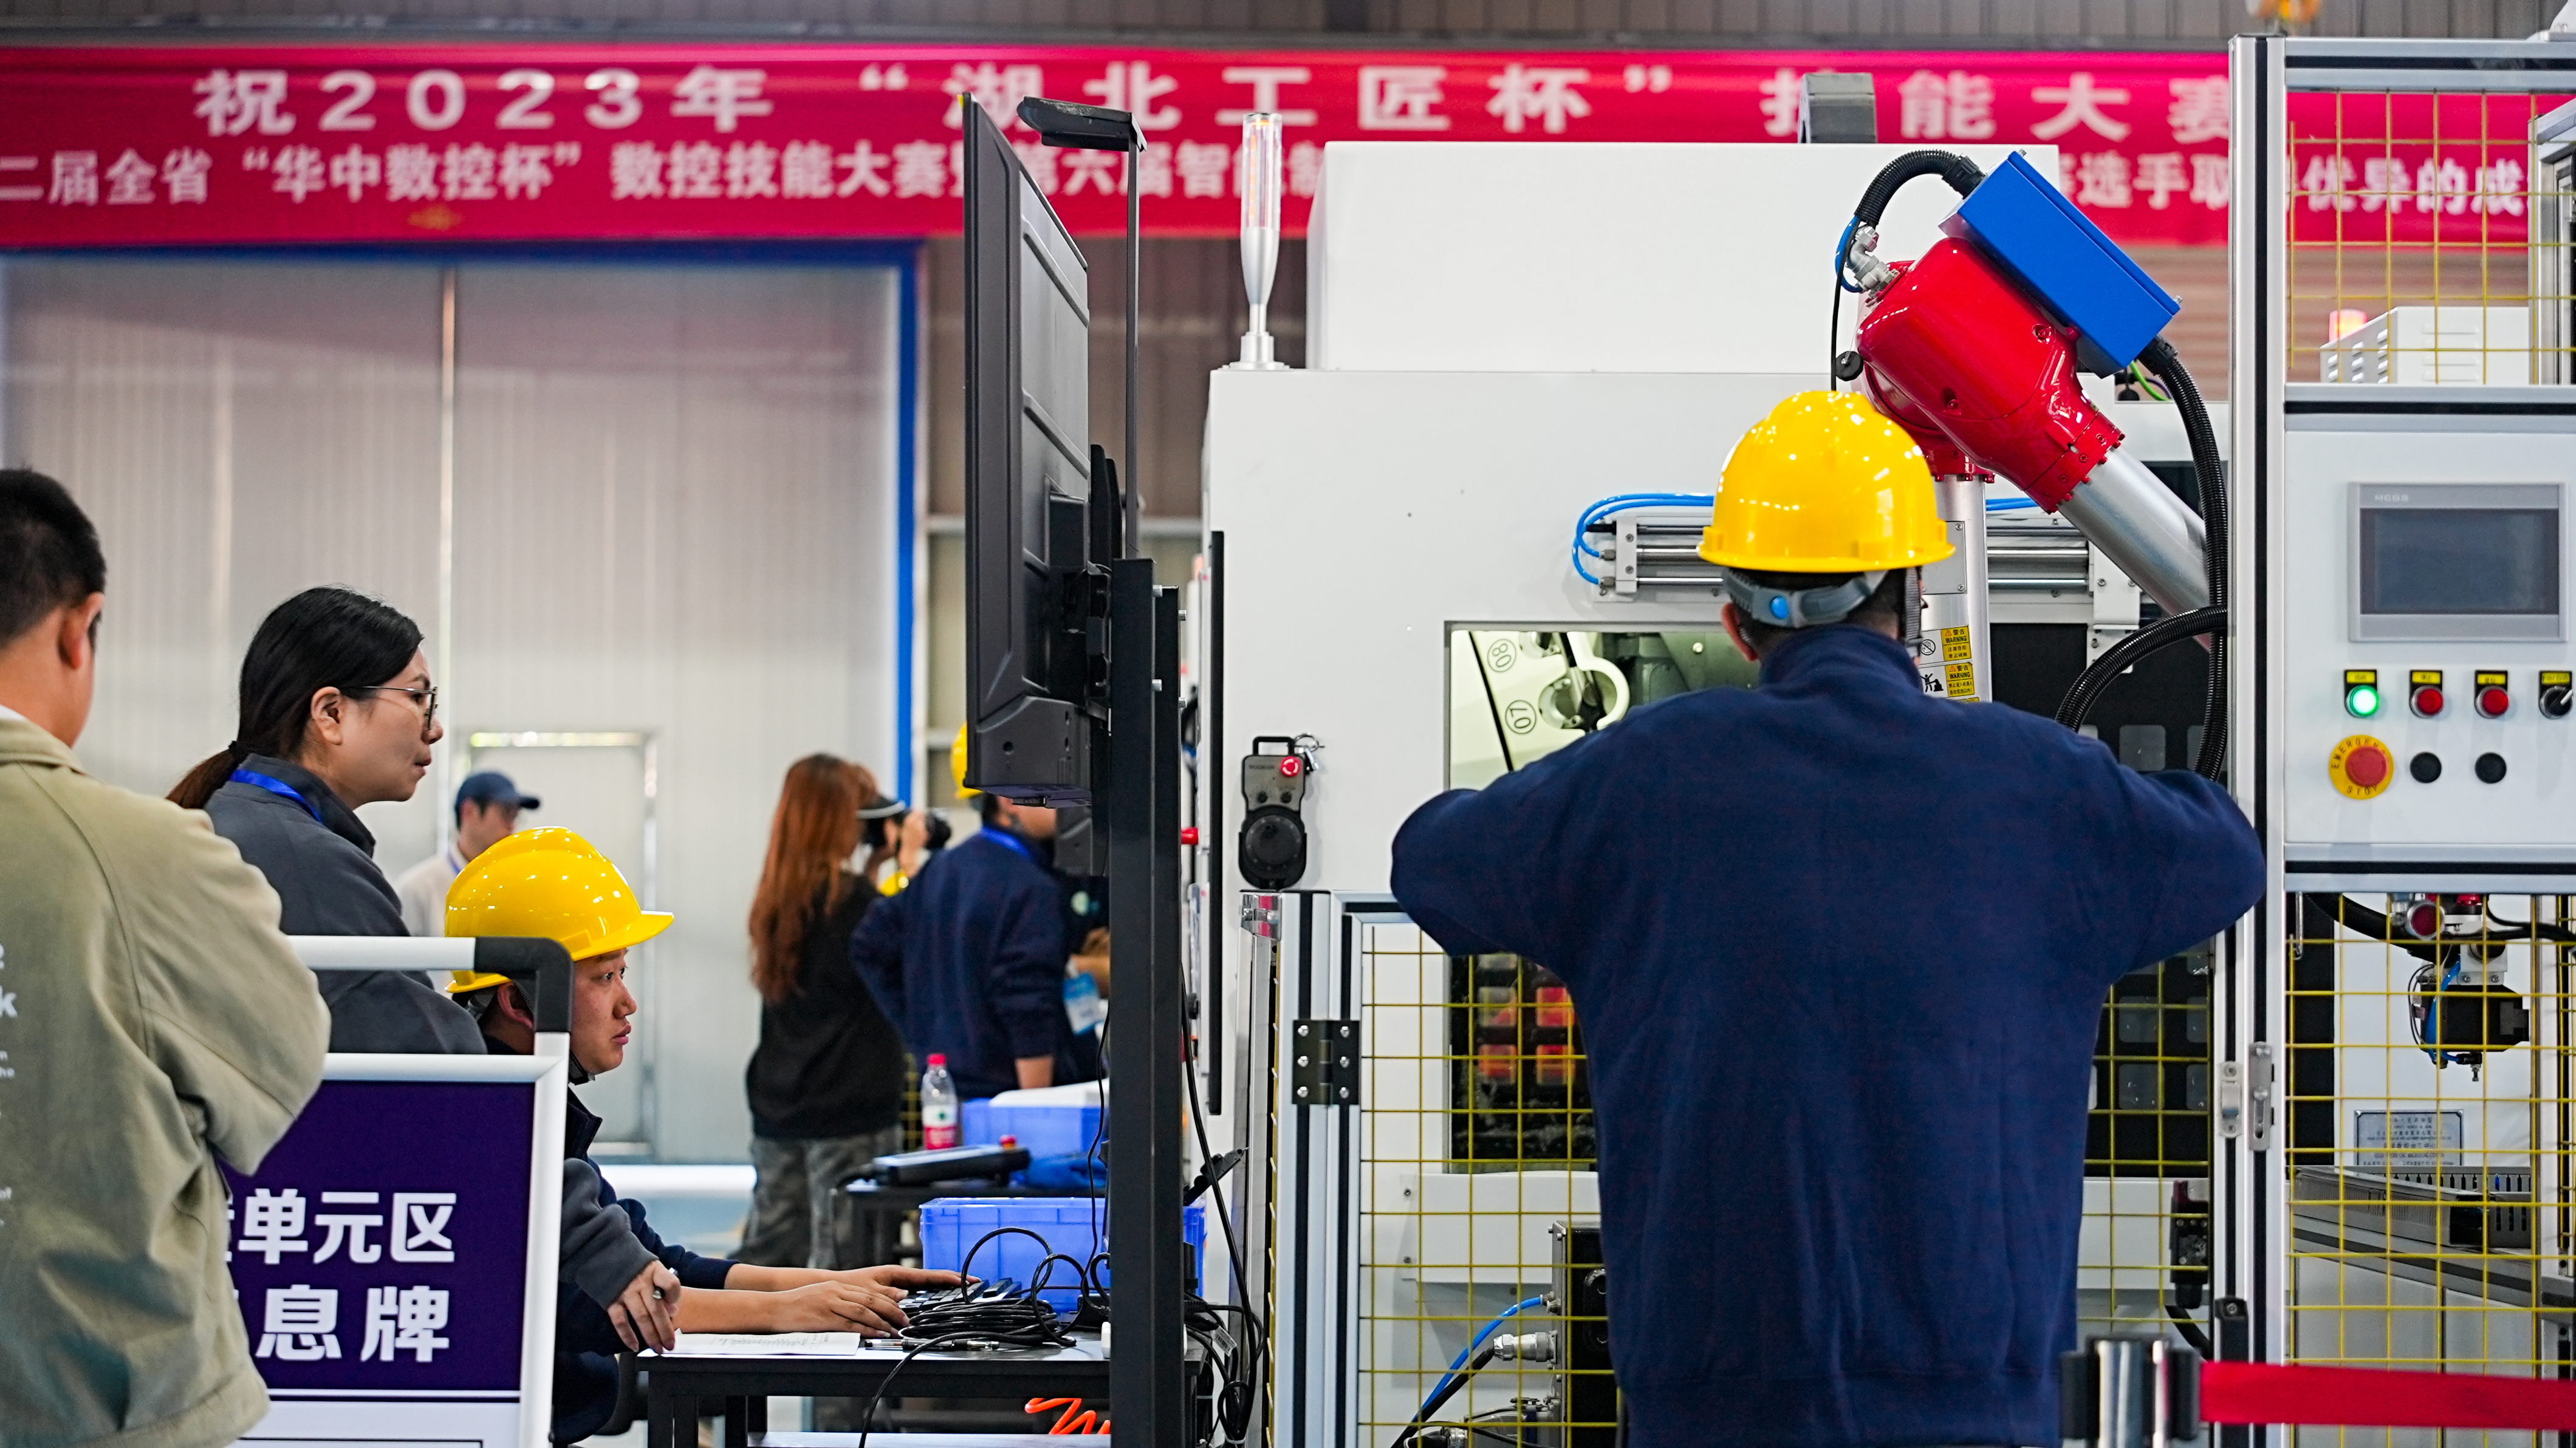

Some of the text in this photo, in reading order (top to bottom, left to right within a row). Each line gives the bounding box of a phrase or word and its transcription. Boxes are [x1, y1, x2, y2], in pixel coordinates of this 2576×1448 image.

[226, 1188, 457, 1265] 单元区
[234, 1284, 450, 1362] 息牌
